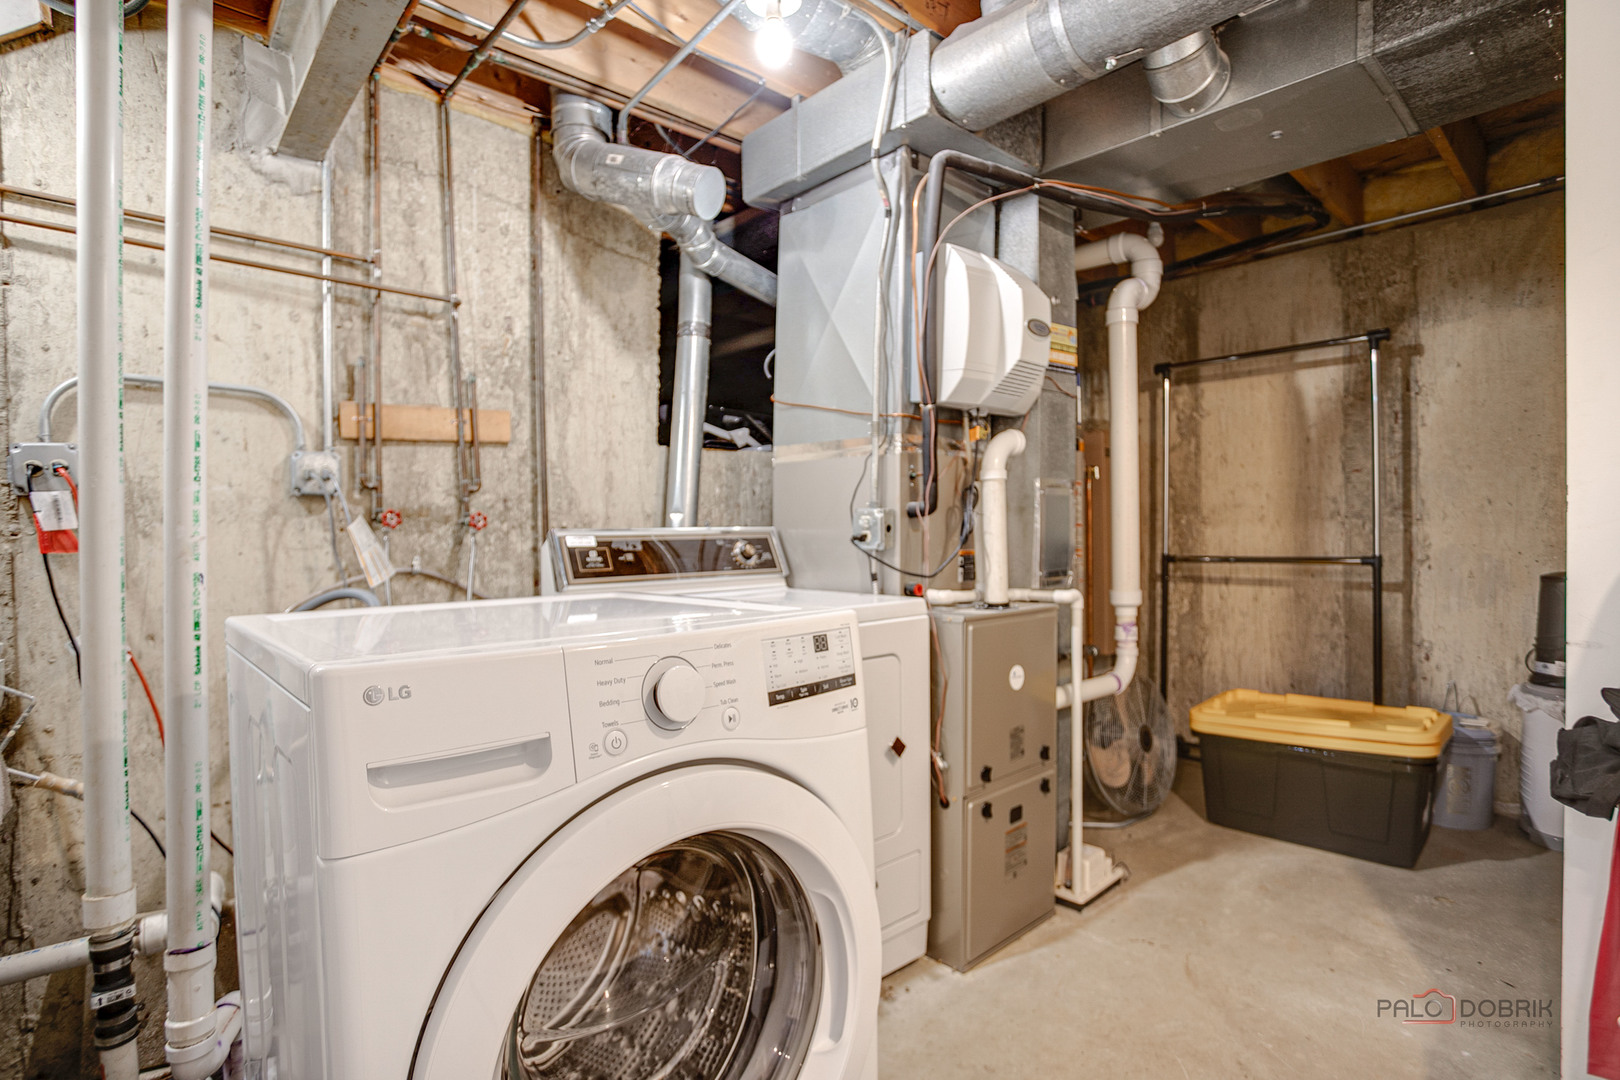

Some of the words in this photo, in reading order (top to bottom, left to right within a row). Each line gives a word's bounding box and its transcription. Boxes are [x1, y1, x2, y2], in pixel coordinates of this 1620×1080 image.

[594, 658, 614, 666] Normal
[613, 677, 626, 685] Duty
[387, 684, 412, 701] LG
[598, 699, 620, 708] Bedding
[601, 720, 619, 729] Towels
